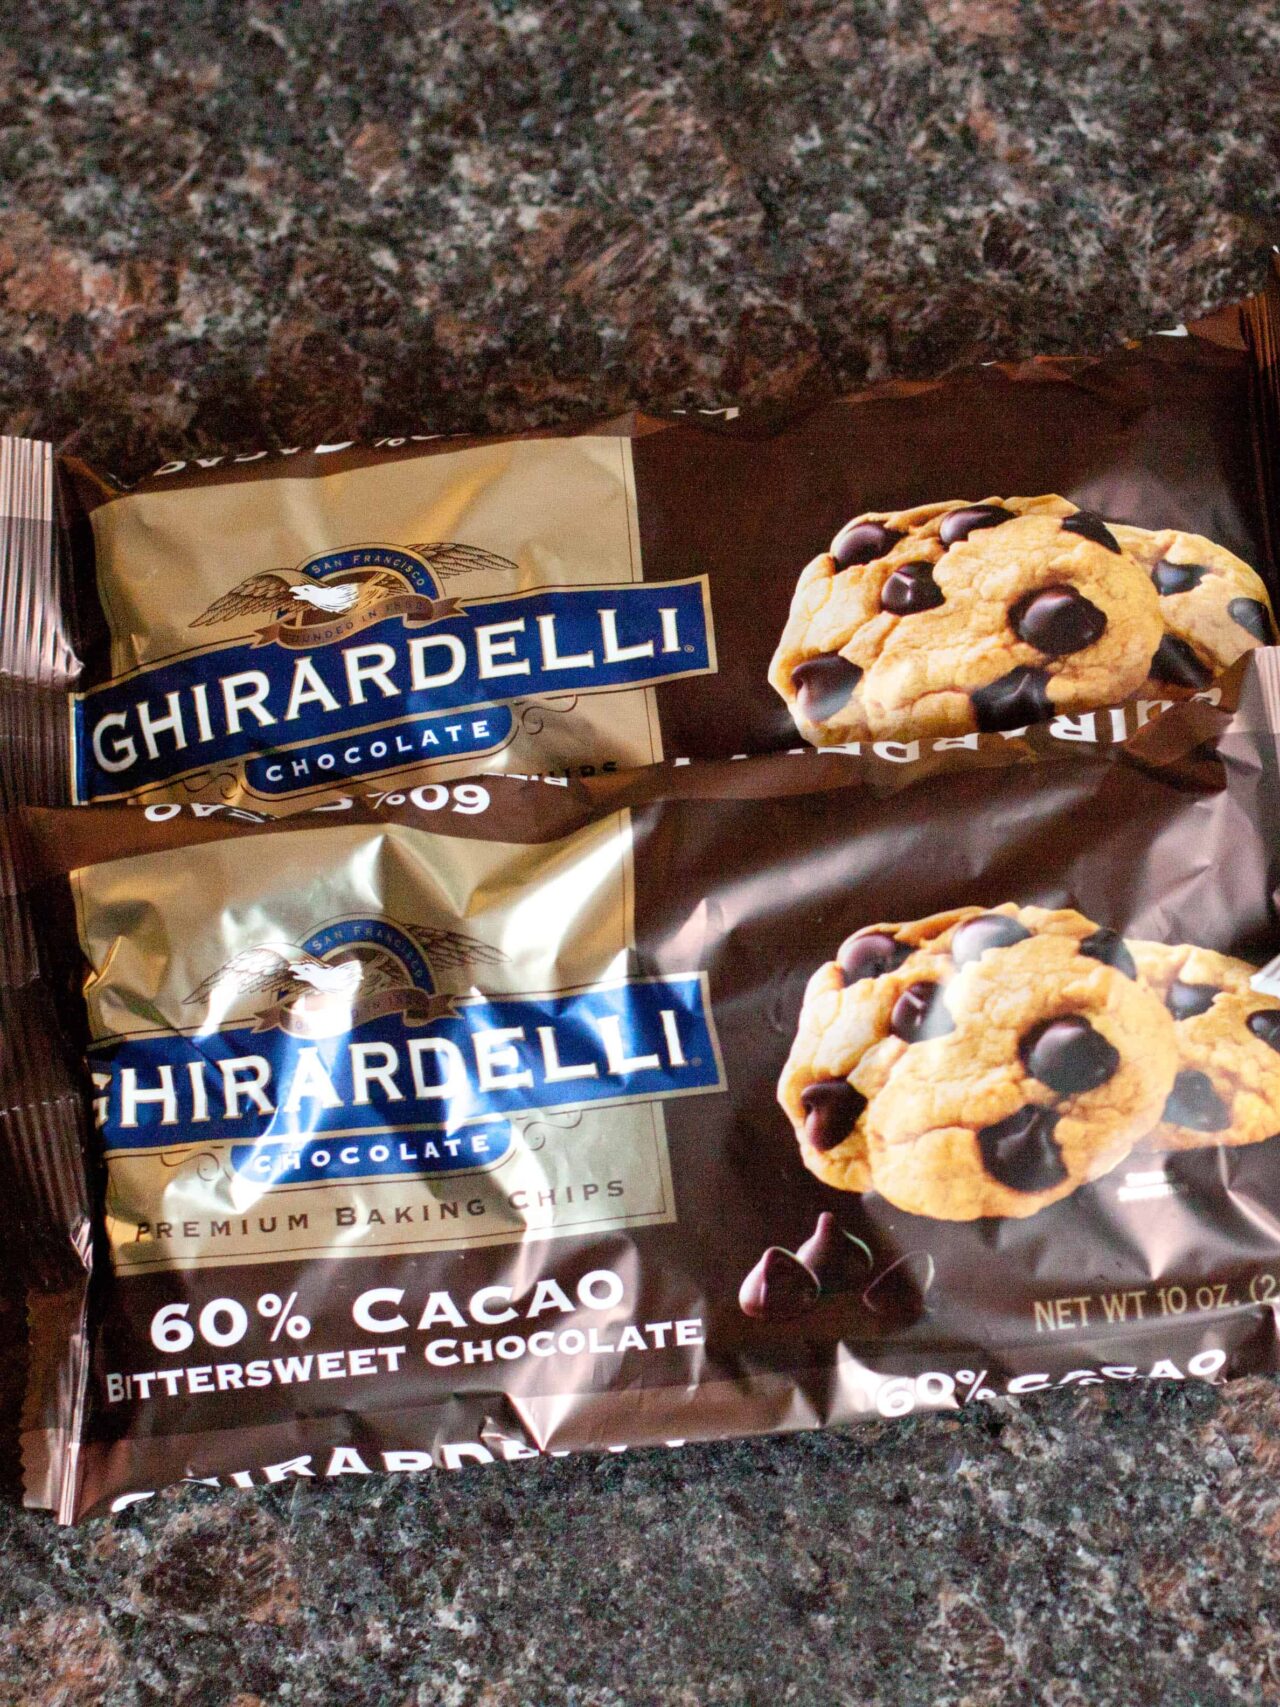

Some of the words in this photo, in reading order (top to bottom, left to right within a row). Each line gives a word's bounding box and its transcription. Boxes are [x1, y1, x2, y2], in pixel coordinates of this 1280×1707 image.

[311, 559, 343, 575] SAN
[353, 554, 426, 588] FRANCISCO
[92, 608, 680, 773] GHIRARDELLI
[264, 718, 493, 783] CHOCOLATE
[311, 930, 343, 950] SAN
[252, 1132, 493, 1173] CHOCOLATE
[135, 1212, 310, 1242] PREMIUM
[335, 1198, 487, 1228] BAKING
[507, 1179, 627, 1211] CHIPS
[150, 1290, 311, 1354] 60%
[352, 1268, 626, 1335] CACAO
[1034, 1297, 1091, 1333] NET
[1099, 1290, 1148, 1324] WT
[1156, 1286, 1188, 1316] 10
[107, 1344, 407, 1402] BITTERSWEET
[424, 1317, 705, 1367] CHOCOLATE
[874, 1369, 998, 1418] 60%
